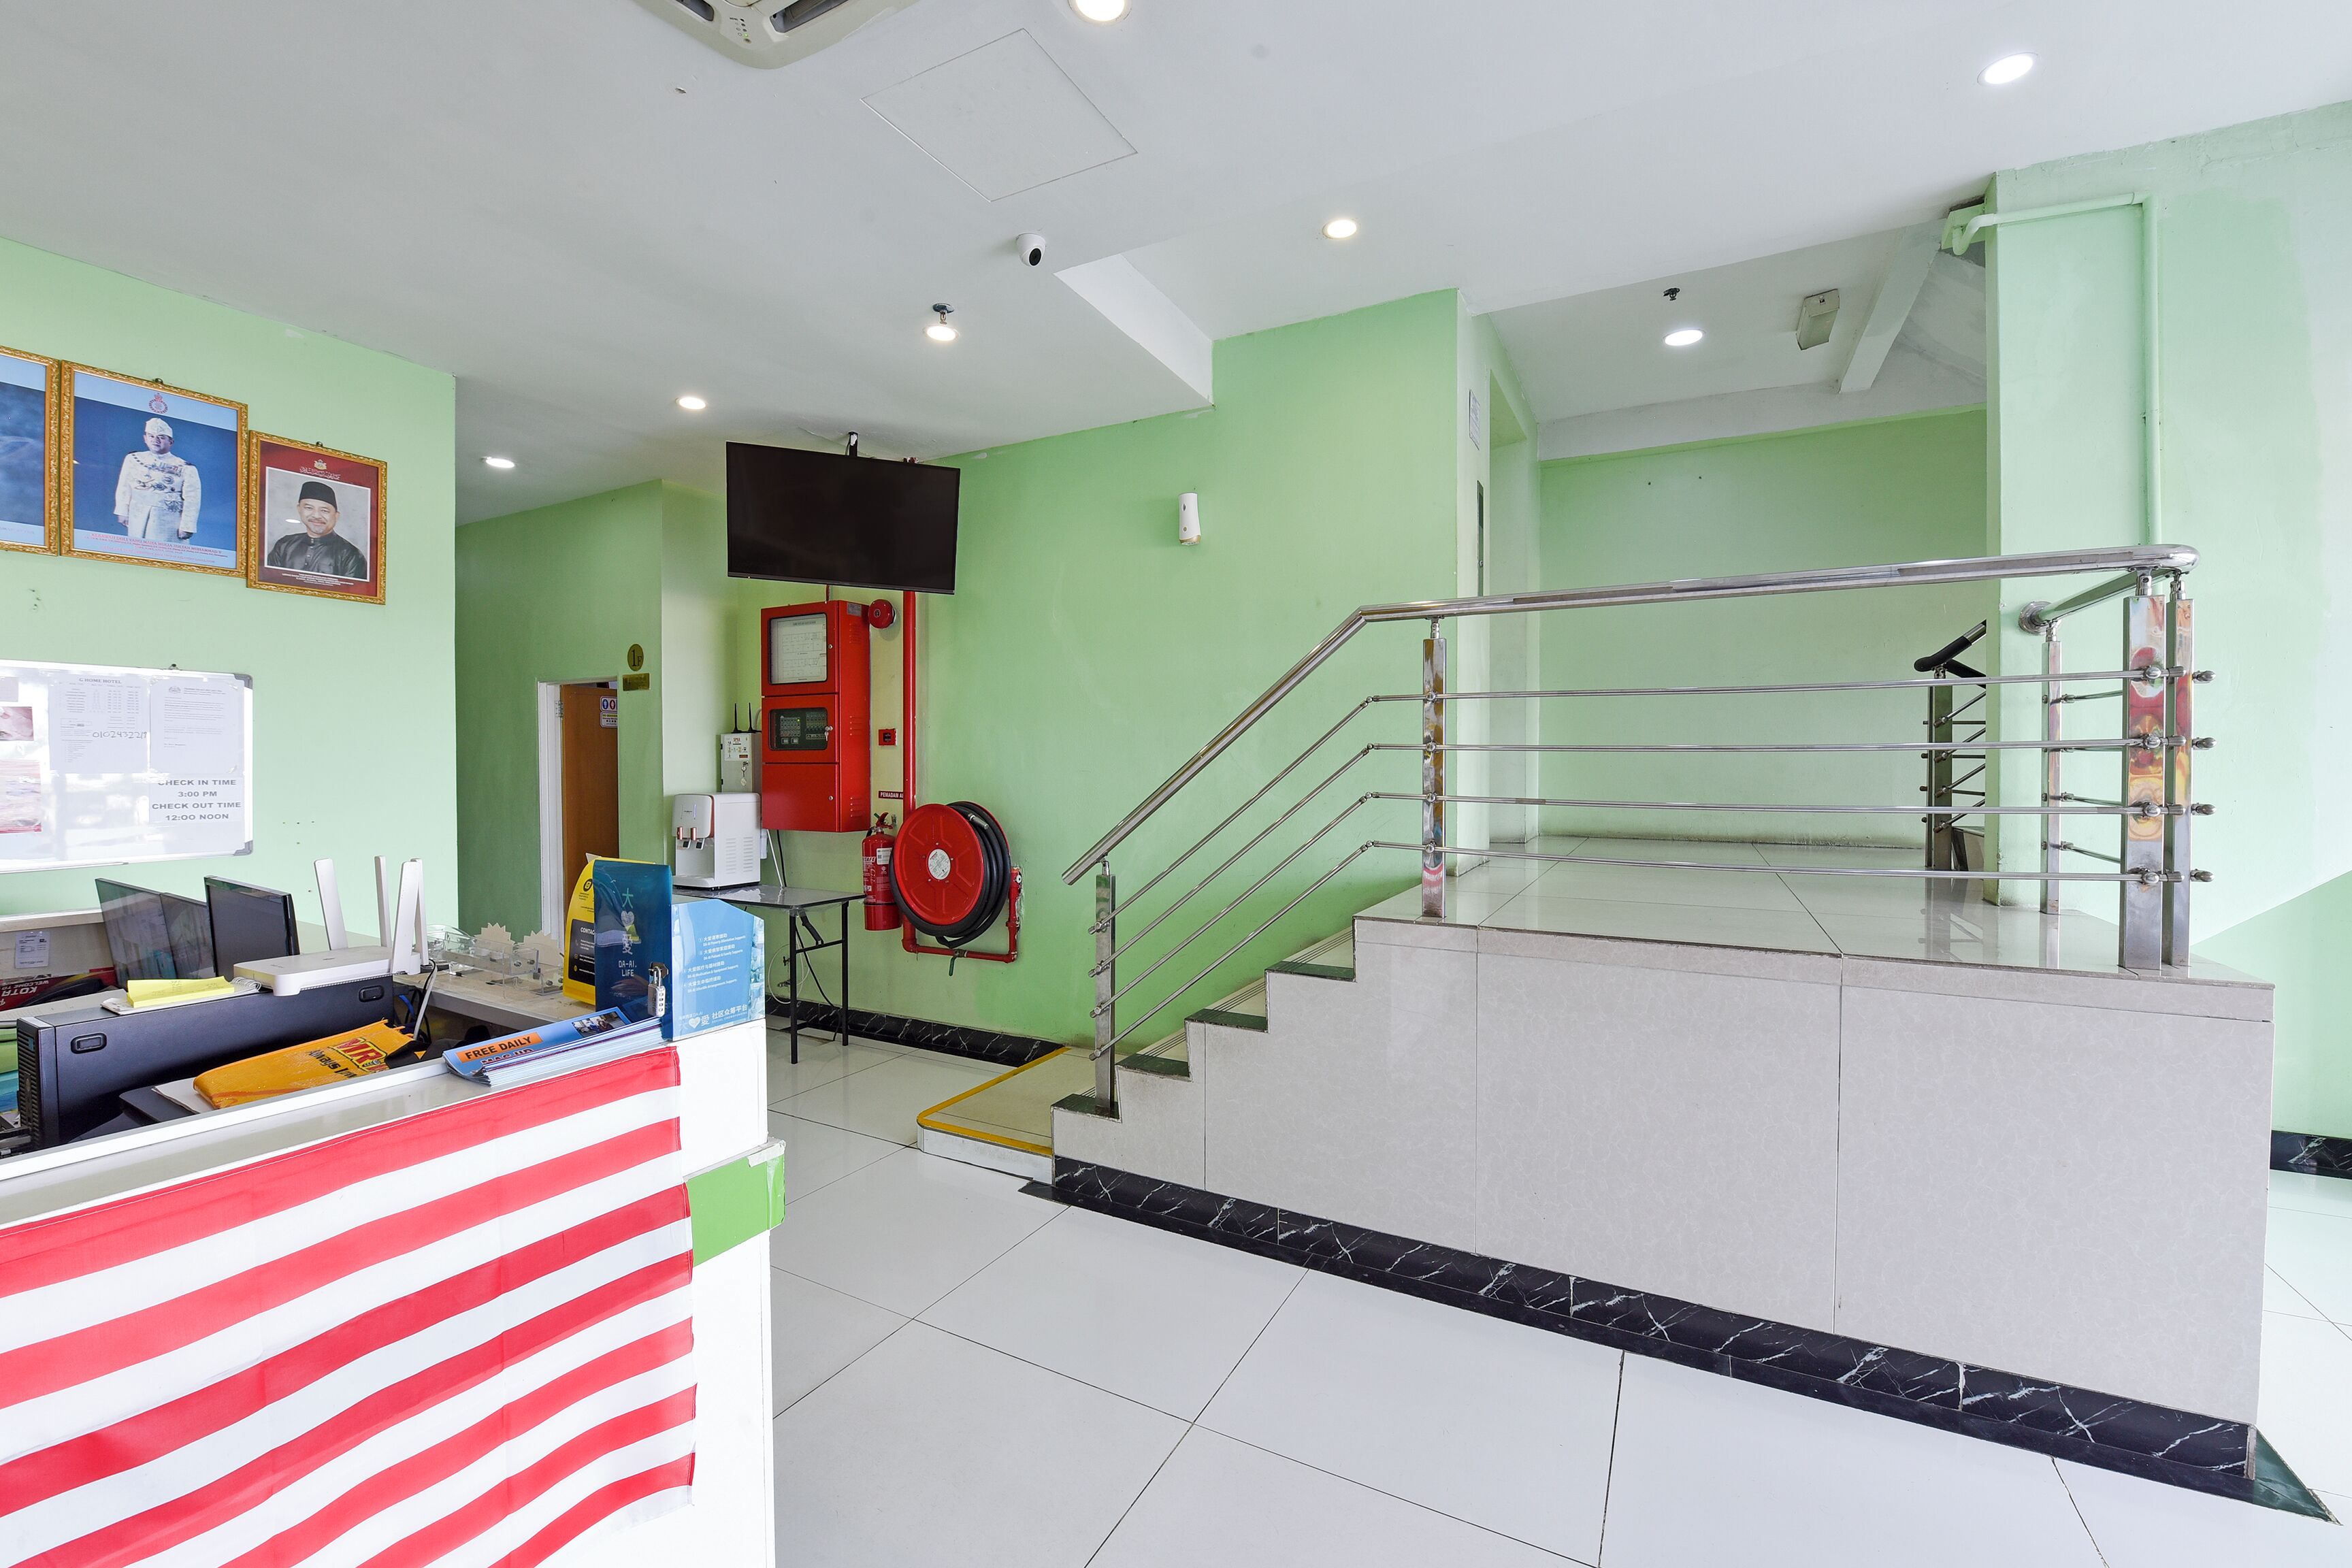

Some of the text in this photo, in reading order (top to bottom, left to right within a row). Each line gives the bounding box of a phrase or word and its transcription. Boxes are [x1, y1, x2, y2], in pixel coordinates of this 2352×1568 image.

[580, 927, 595, 935] CONTAC
[1, 986, 38, 997] KOTA
[465, 1046, 497, 1060] FREE
[499, 1036, 532, 1050] DAILY
[308, 1049, 341, 1071] Always
